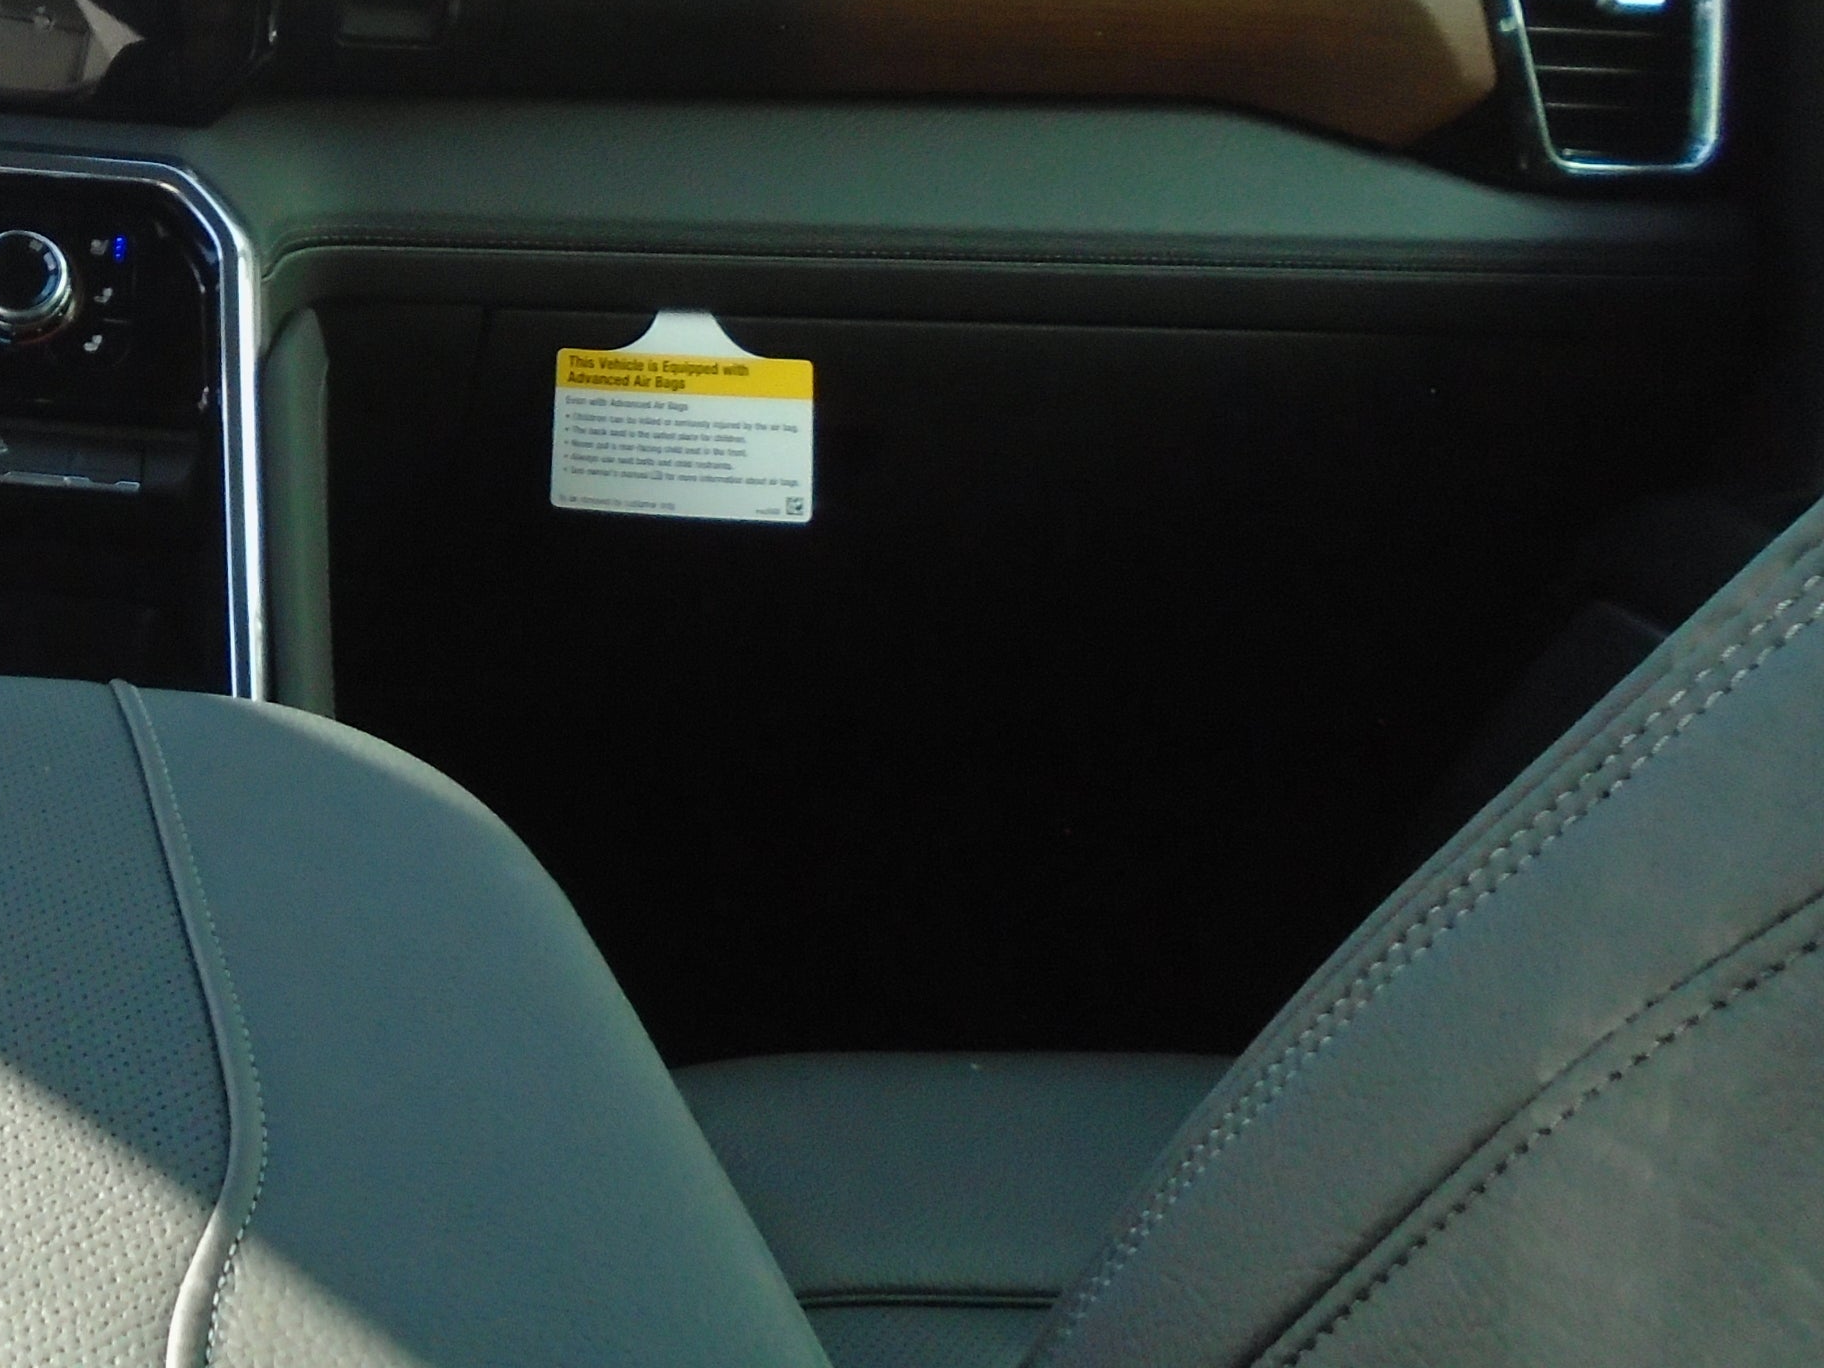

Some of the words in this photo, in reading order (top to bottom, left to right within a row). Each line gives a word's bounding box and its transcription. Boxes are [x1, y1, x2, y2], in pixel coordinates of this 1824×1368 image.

[569, 355, 595, 369] This
[598, 358, 645, 372] Vehicle
[647, 360, 659, 372] is
[662, 360, 719, 376] Equipped
[722, 364, 750, 377] with
[567, 371, 630, 387] Advanced
[633, 375, 652, 387] Air
[655, 376, 686, 391] Bags
